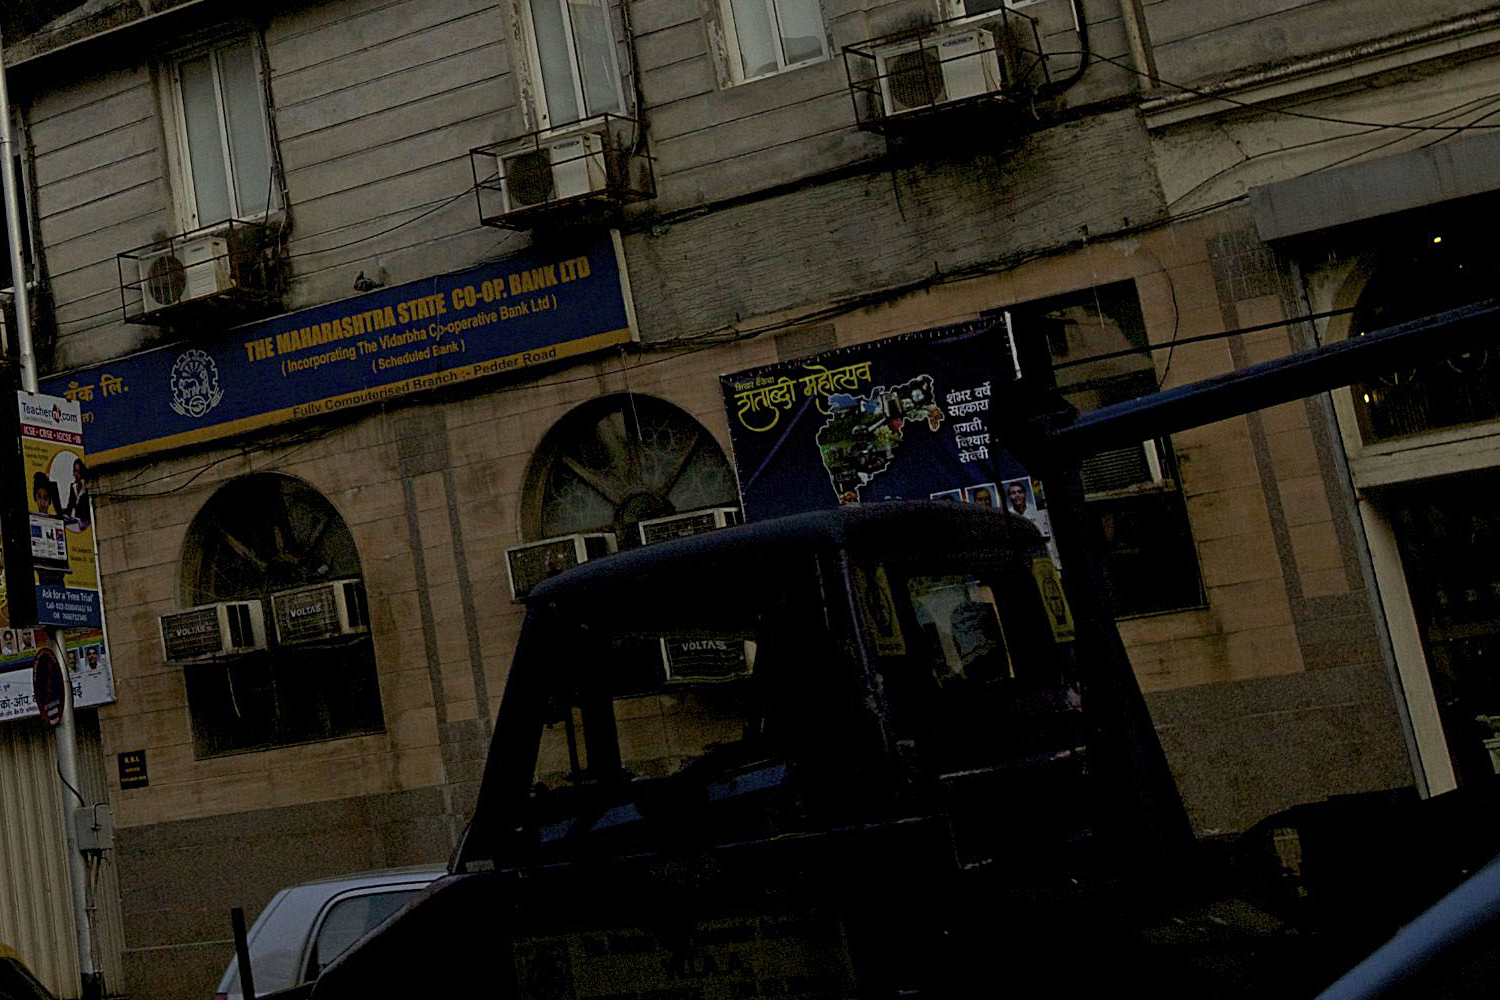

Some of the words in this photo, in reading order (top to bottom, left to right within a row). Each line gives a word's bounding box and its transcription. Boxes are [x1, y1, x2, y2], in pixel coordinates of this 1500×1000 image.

[244, 336, 275, 362] THE
[276, 305, 397, 356] MAHARASHTRA
[397, 292, 448, 325] STATE
[451, 277, 508, 311] CO-OP.
[508, 263, 559, 296] BANK
[558, 255, 592, 284] LTD
[357, 340, 378, 356] The
[379, 328, 428, 350] Vidarbha
[428, 310, 498, 338] Co-operative
[499, 303, 529, 320] Bank
[292, 404, 321, 420] Fully
[325, 381, 410, 411] Computerised
[413, 373, 458, 390] Branch
[473, 358, 519, 376] Pedder
[523, 349, 557, 365] Road
[42, 589, 52, 599] Ask
[52, 589, 61, 599] for
[290, 604, 322, 618] VOLTAS
[176, 626, 206, 638] VOLTAS
[681, 639, 728, 652] VOLTAS
